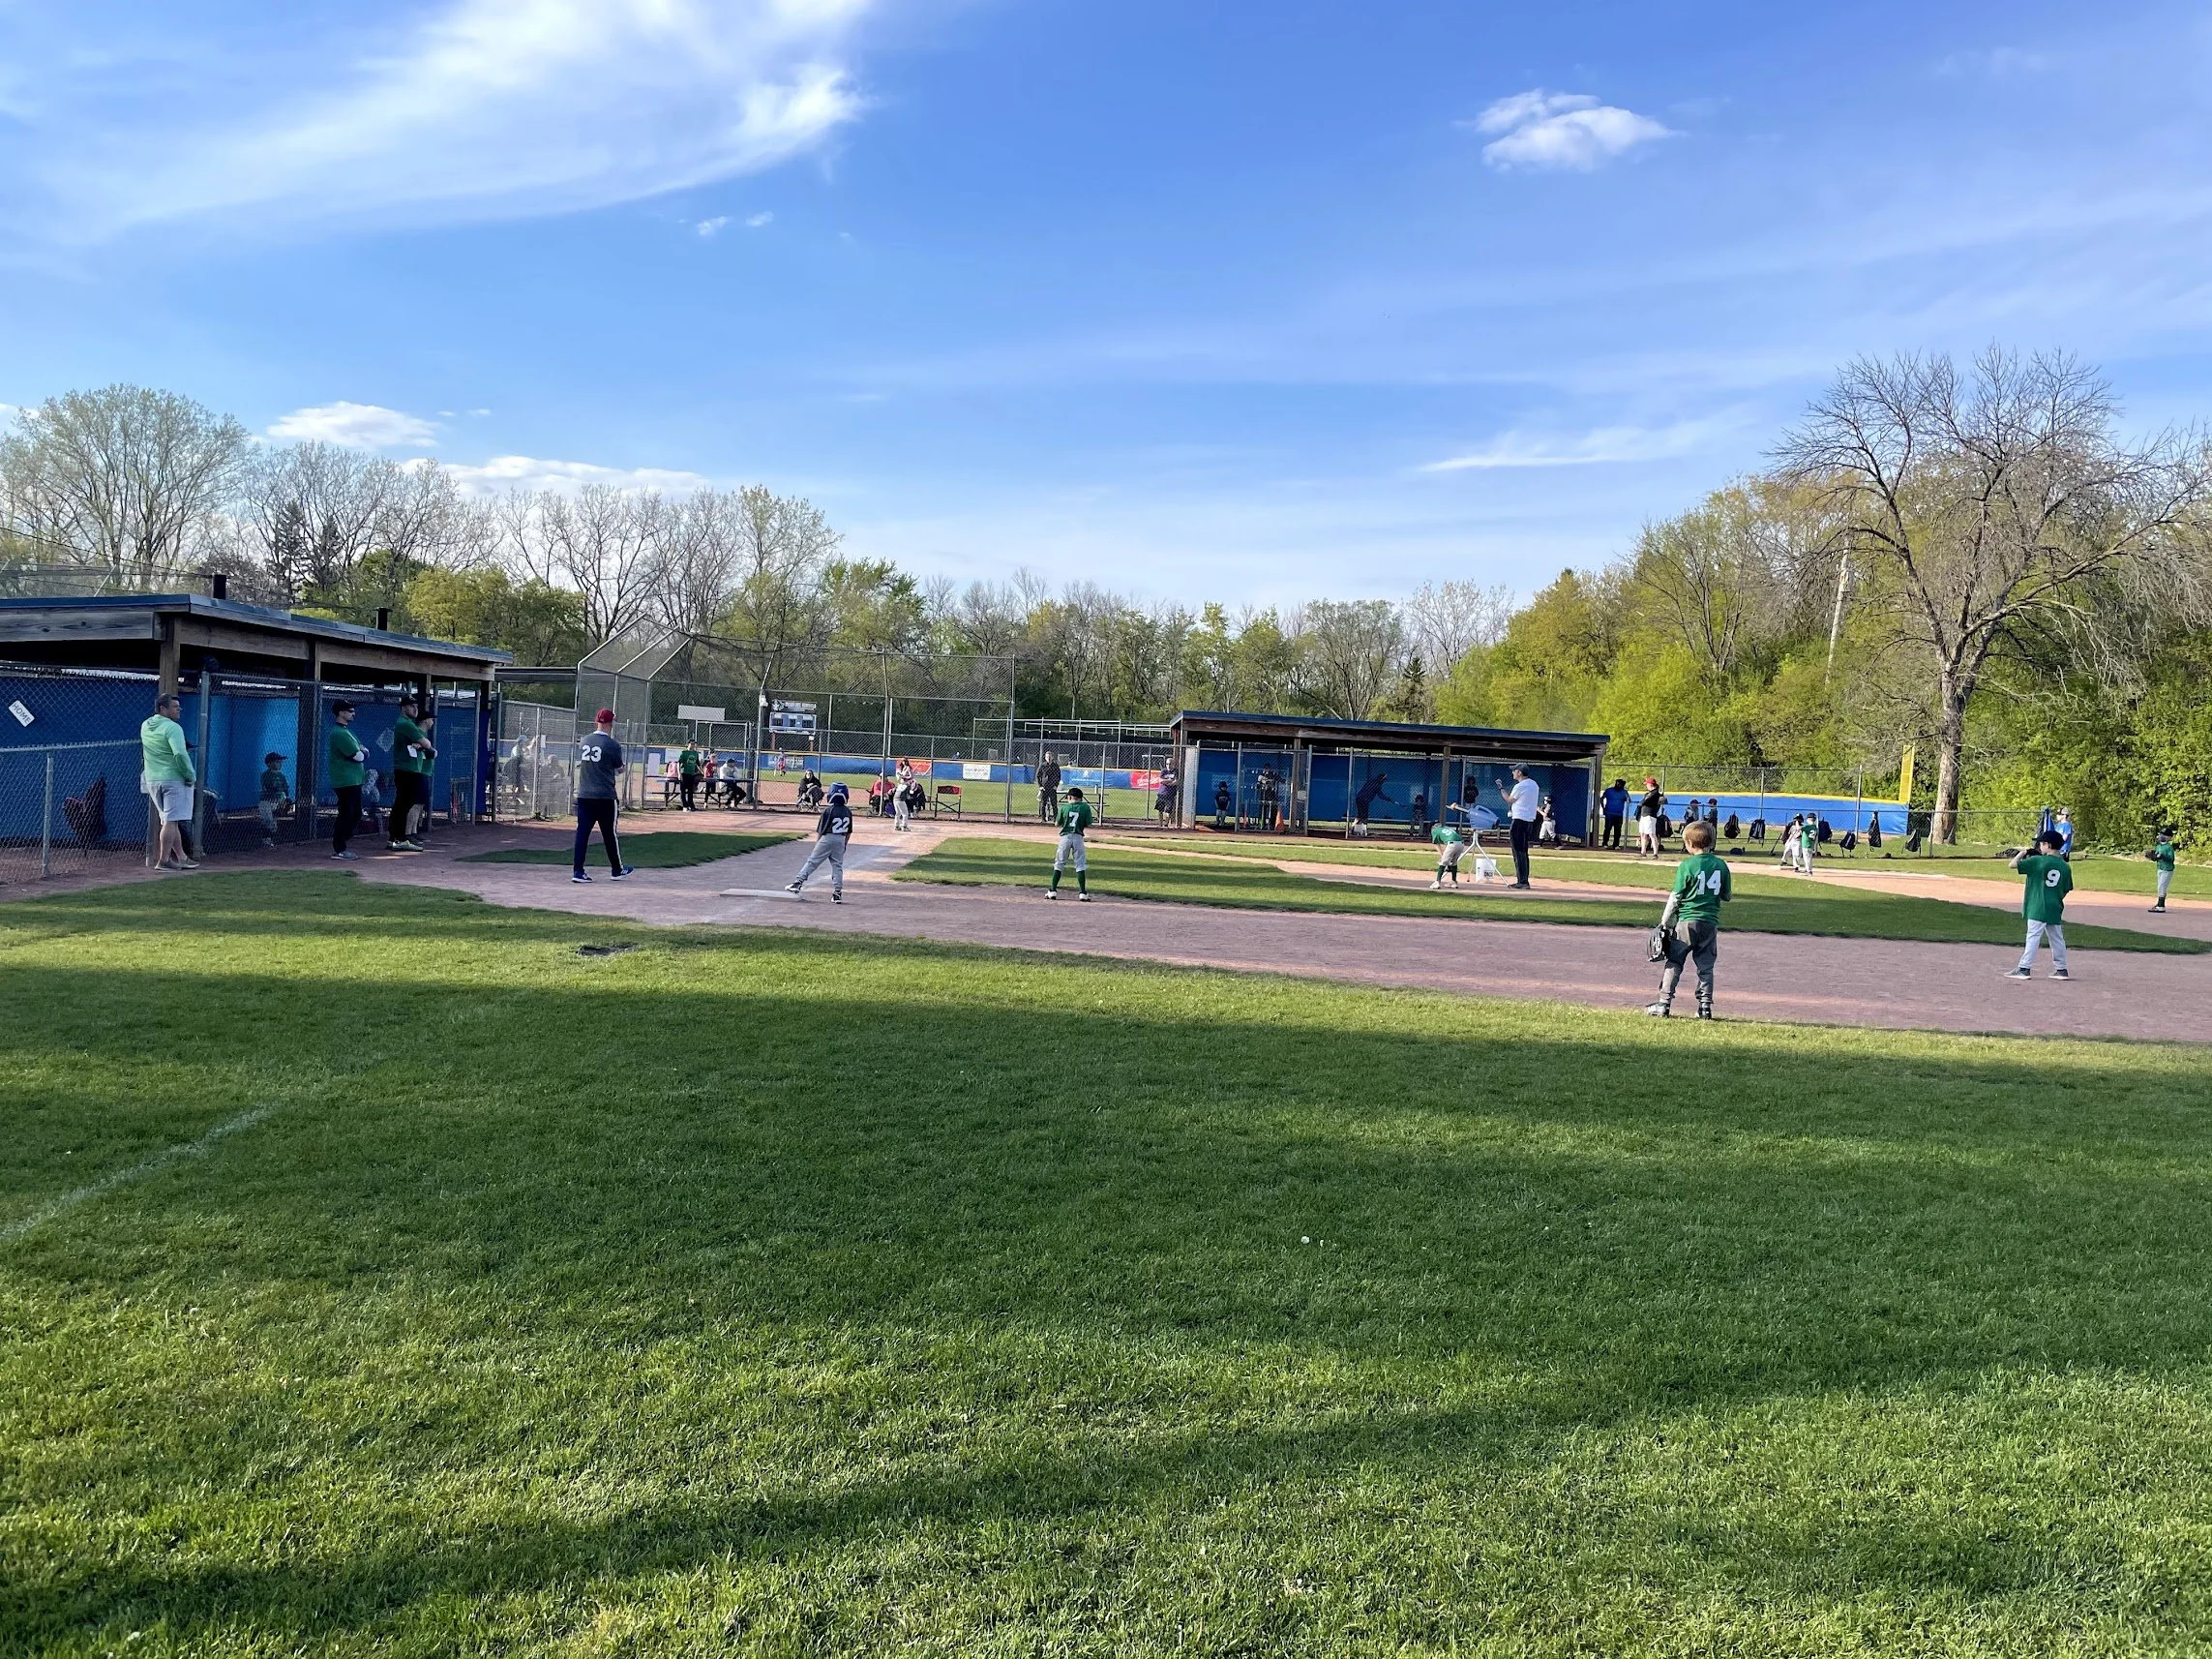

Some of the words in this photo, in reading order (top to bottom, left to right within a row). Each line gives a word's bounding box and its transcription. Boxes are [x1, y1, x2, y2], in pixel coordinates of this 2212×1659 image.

[12, 703, 32, 724] HOME
[581, 744, 602, 762] 23
[831, 816, 851, 833] 22
[1068, 811, 1080, 828] 7
[1696, 869, 1721, 896] 14
[2045, 868, 2061, 888] 9
